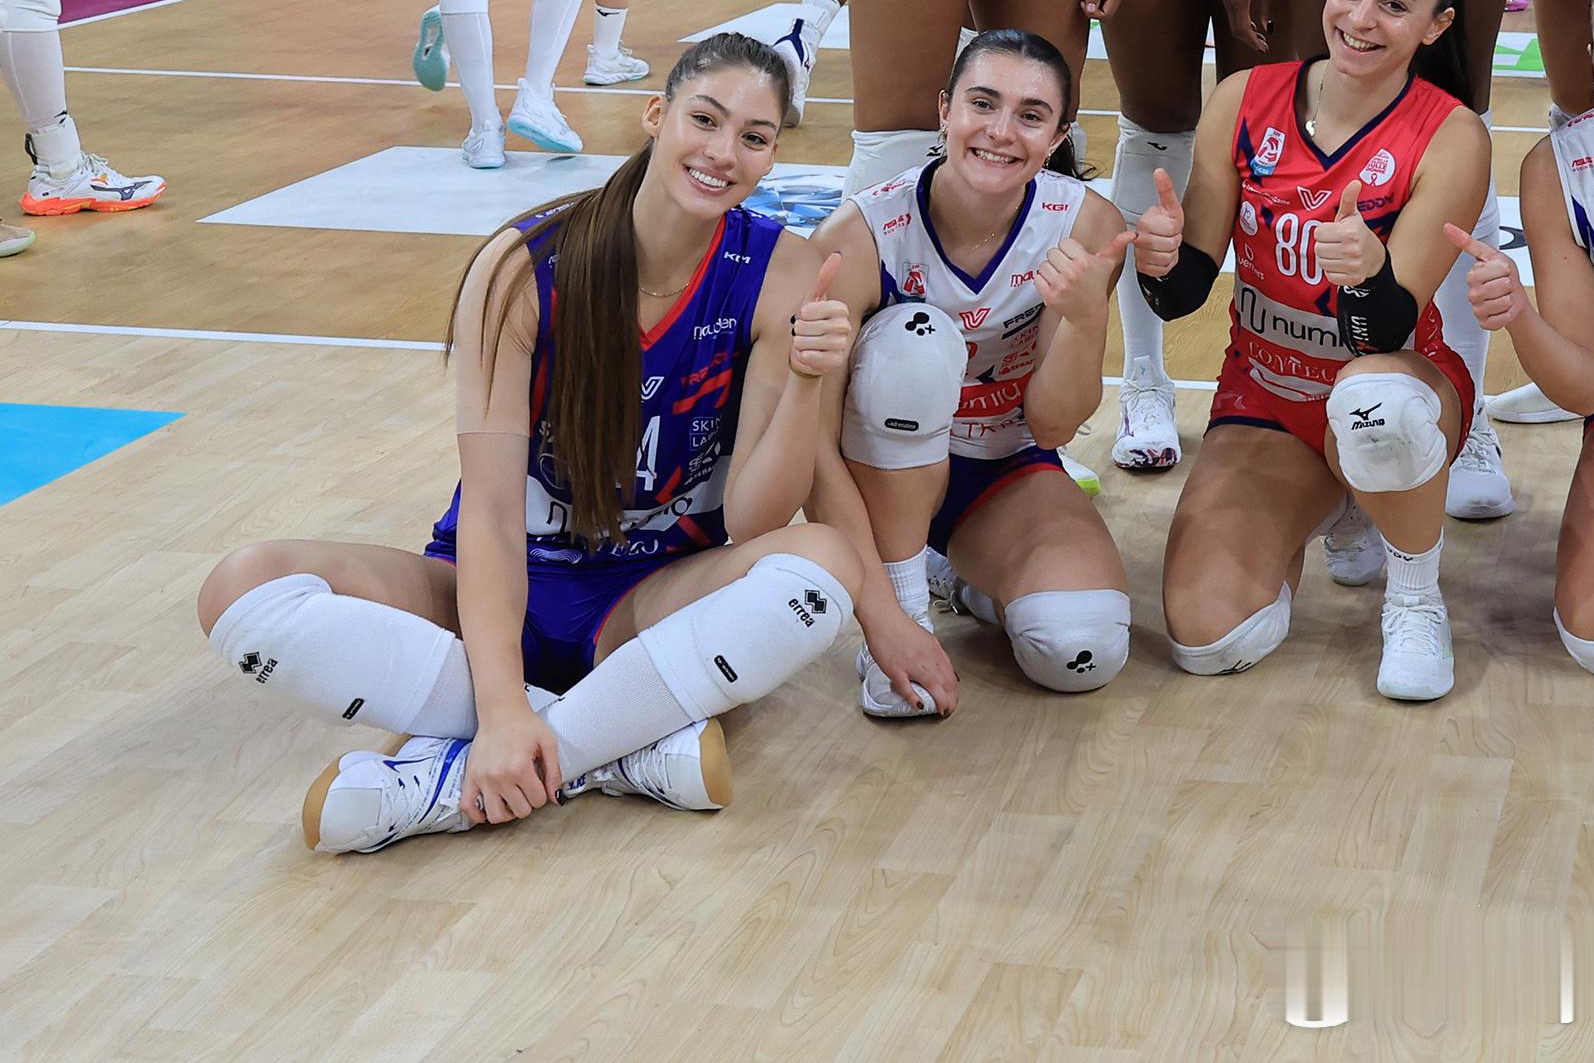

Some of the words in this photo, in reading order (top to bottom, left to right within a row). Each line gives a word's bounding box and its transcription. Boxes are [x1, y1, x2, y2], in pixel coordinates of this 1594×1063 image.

[1275, 212, 1323, 286] 80
[1248, 341, 1337, 384] CONTEC
[788, 597, 816, 628] errea
